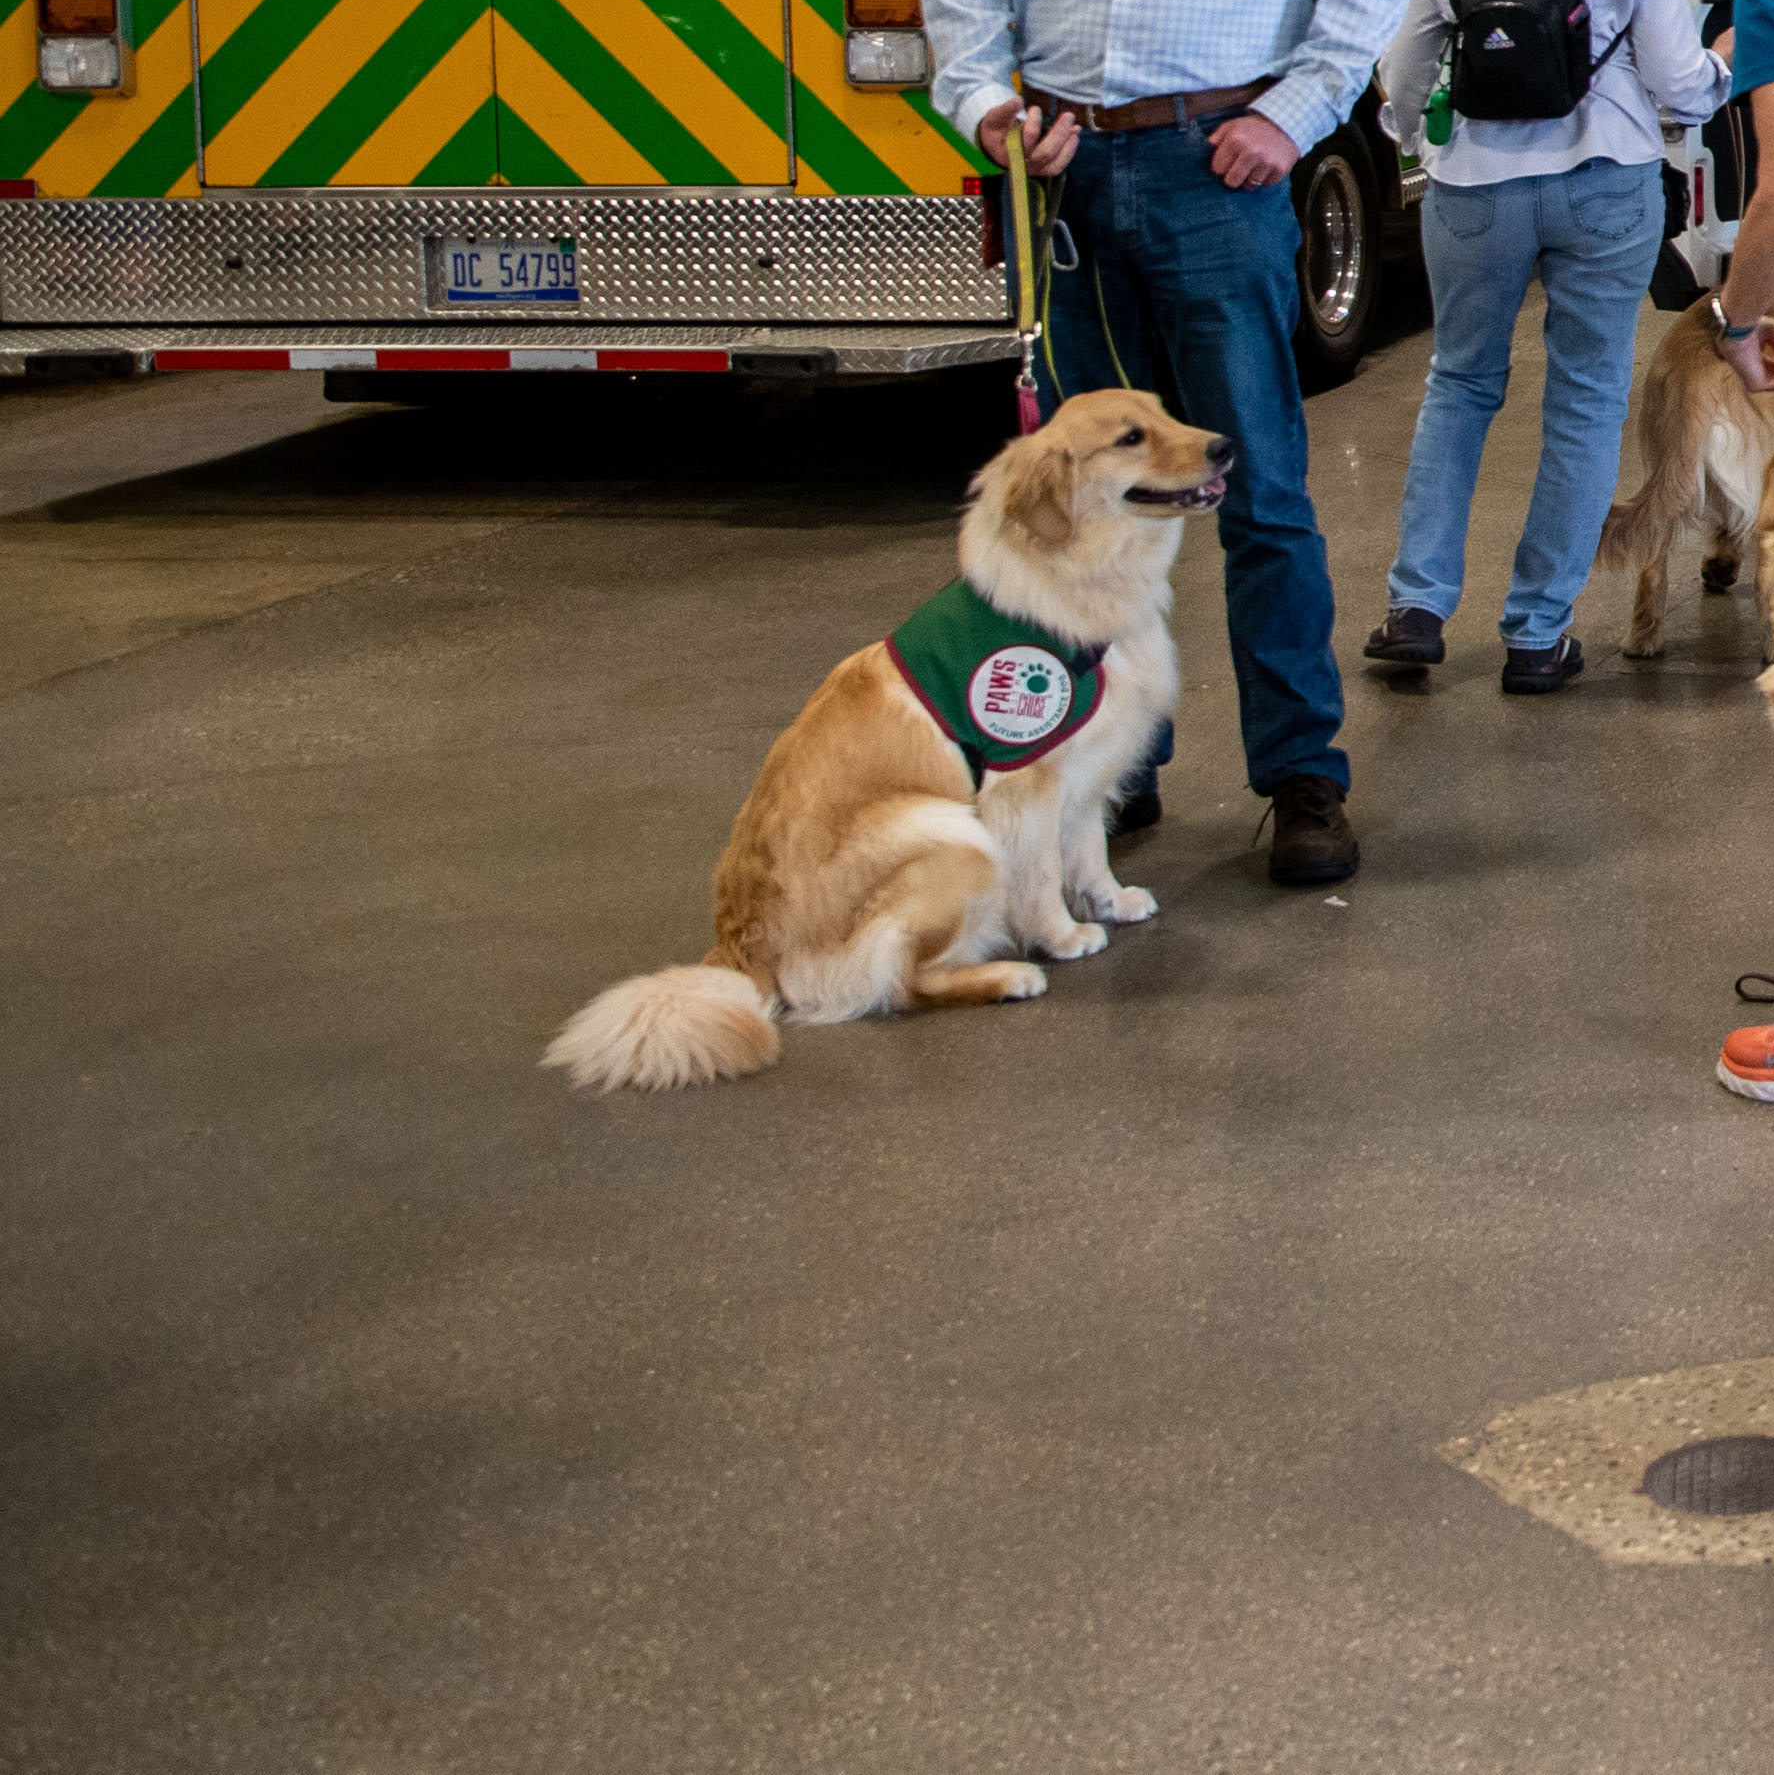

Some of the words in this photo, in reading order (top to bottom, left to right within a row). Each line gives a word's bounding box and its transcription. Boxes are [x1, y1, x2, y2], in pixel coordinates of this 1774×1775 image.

[499, 252, 575, 287] 54799
[984, 659, 1017, 714] PAWS
[988, 721, 1025, 739] FUTURE
[1028, 696, 1069, 739] ASSISTANCE
